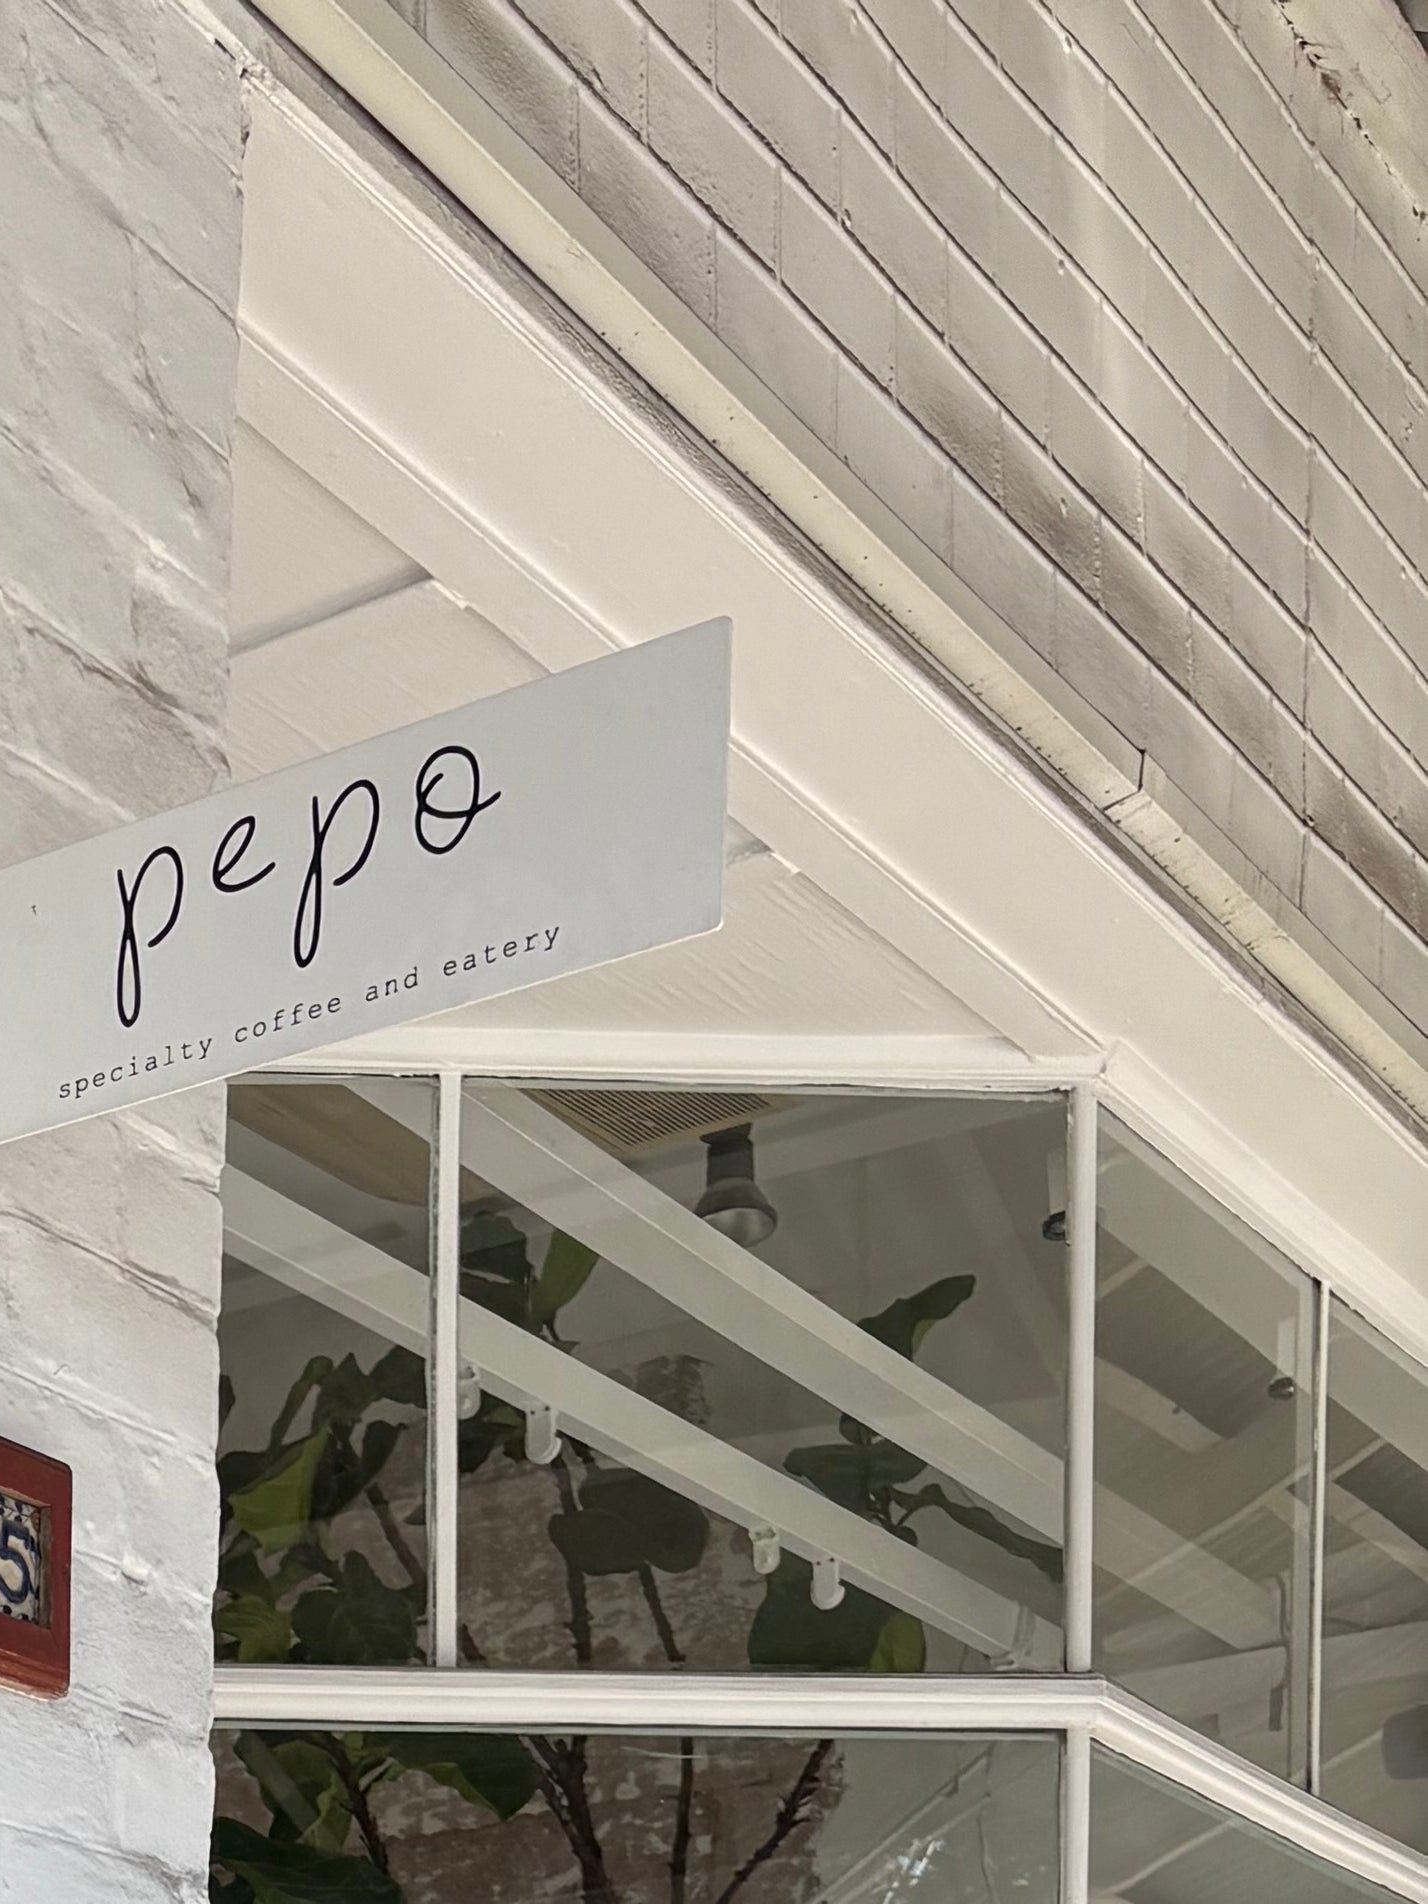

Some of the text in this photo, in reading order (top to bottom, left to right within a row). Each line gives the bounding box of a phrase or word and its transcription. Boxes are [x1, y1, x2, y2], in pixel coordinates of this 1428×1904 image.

[116, 744, 502, 1029] pepo
[57, 923, 562, 1101] specialty coffee and eatery
